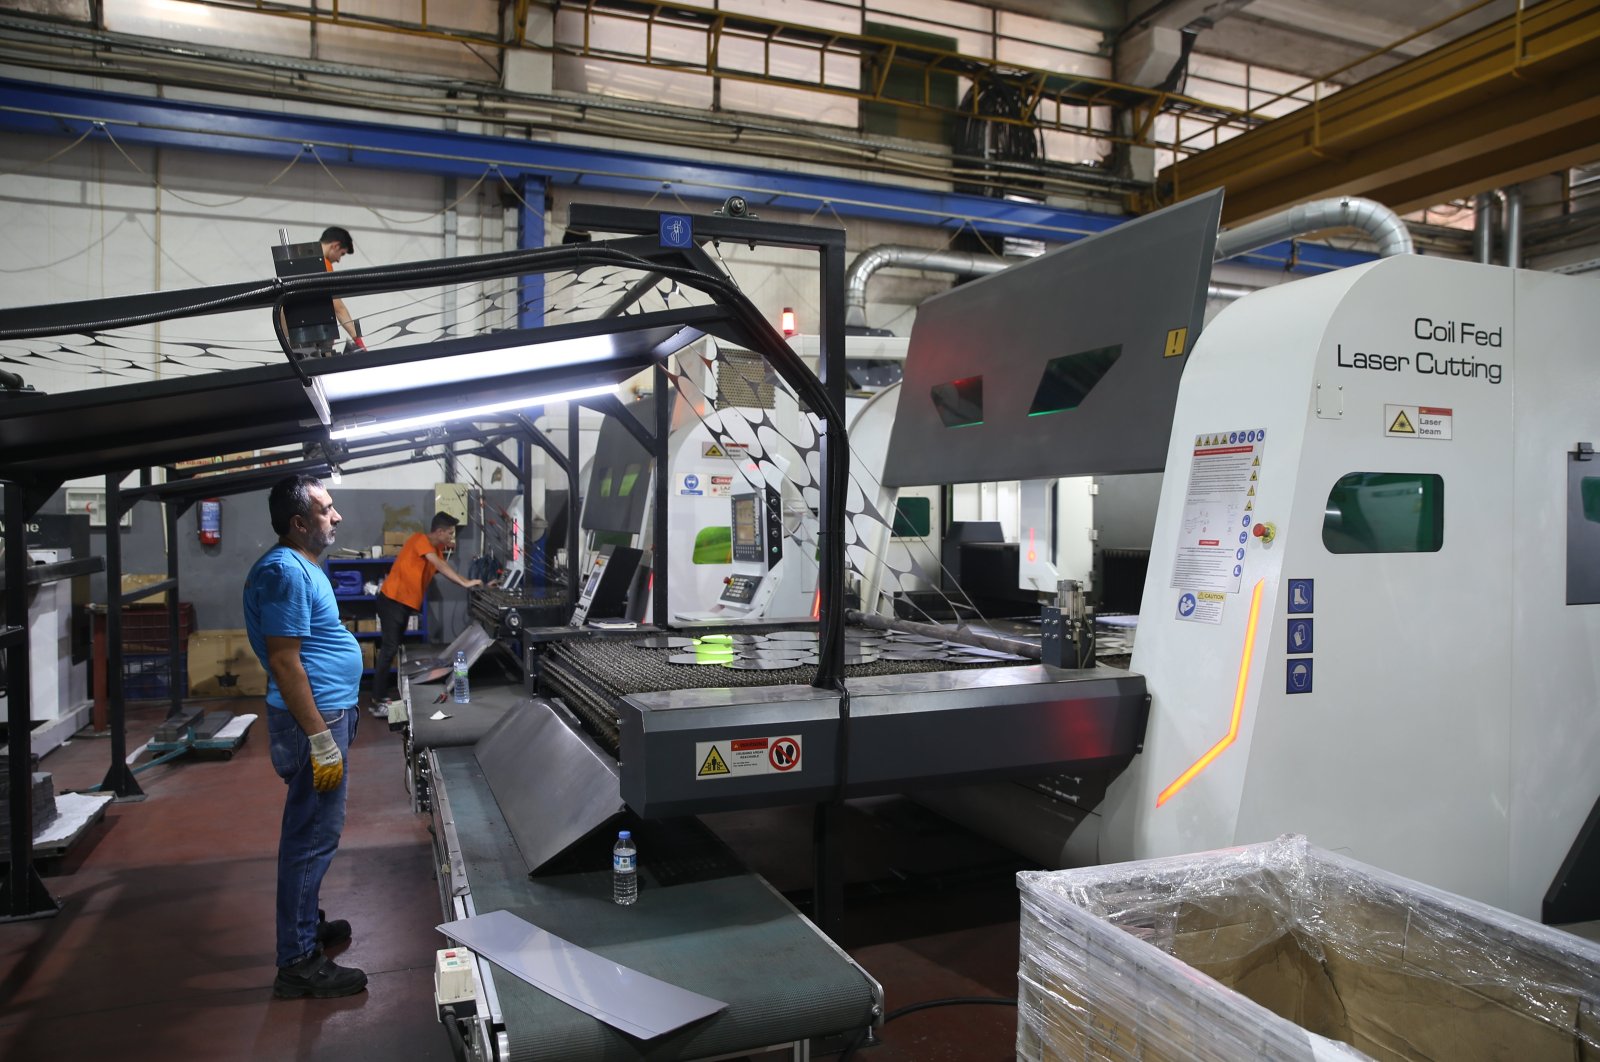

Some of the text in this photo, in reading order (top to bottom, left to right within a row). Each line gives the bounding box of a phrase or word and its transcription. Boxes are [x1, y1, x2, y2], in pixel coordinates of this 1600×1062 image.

[1414, 317, 1502, 347] Coil Fed
[1337, 344, 1502, 384] Laser Cutting
[1419, 417, 1442, 426] Laser
[1419, 427, 1442, 435] beam
